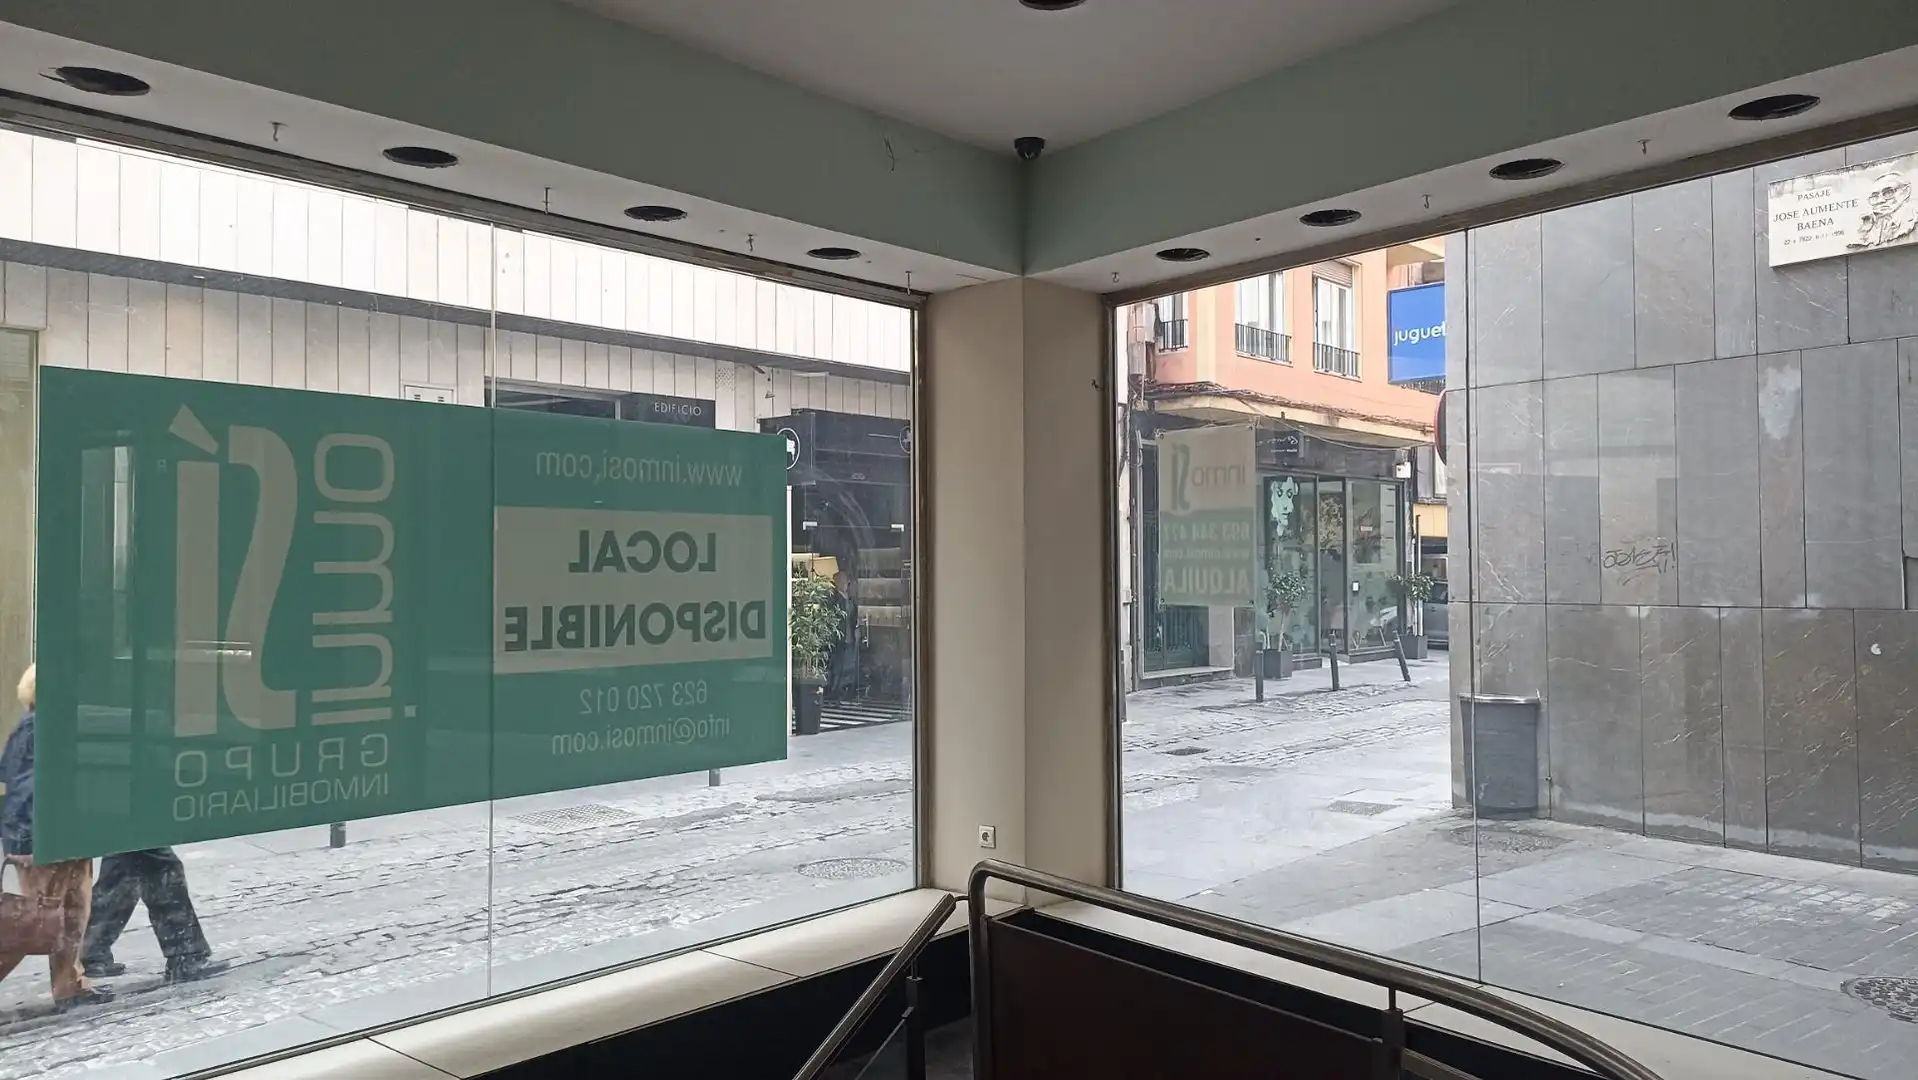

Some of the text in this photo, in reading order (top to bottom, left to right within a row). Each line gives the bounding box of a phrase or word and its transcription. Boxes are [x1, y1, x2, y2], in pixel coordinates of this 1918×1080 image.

[1798, 189, 1831, 201] PASAJE
[1803, 199, 1858, 216] AUMENTE
[1797, 218, 1834, 231] BAENA
[654, 402, 702, 416] EDIFICIO
